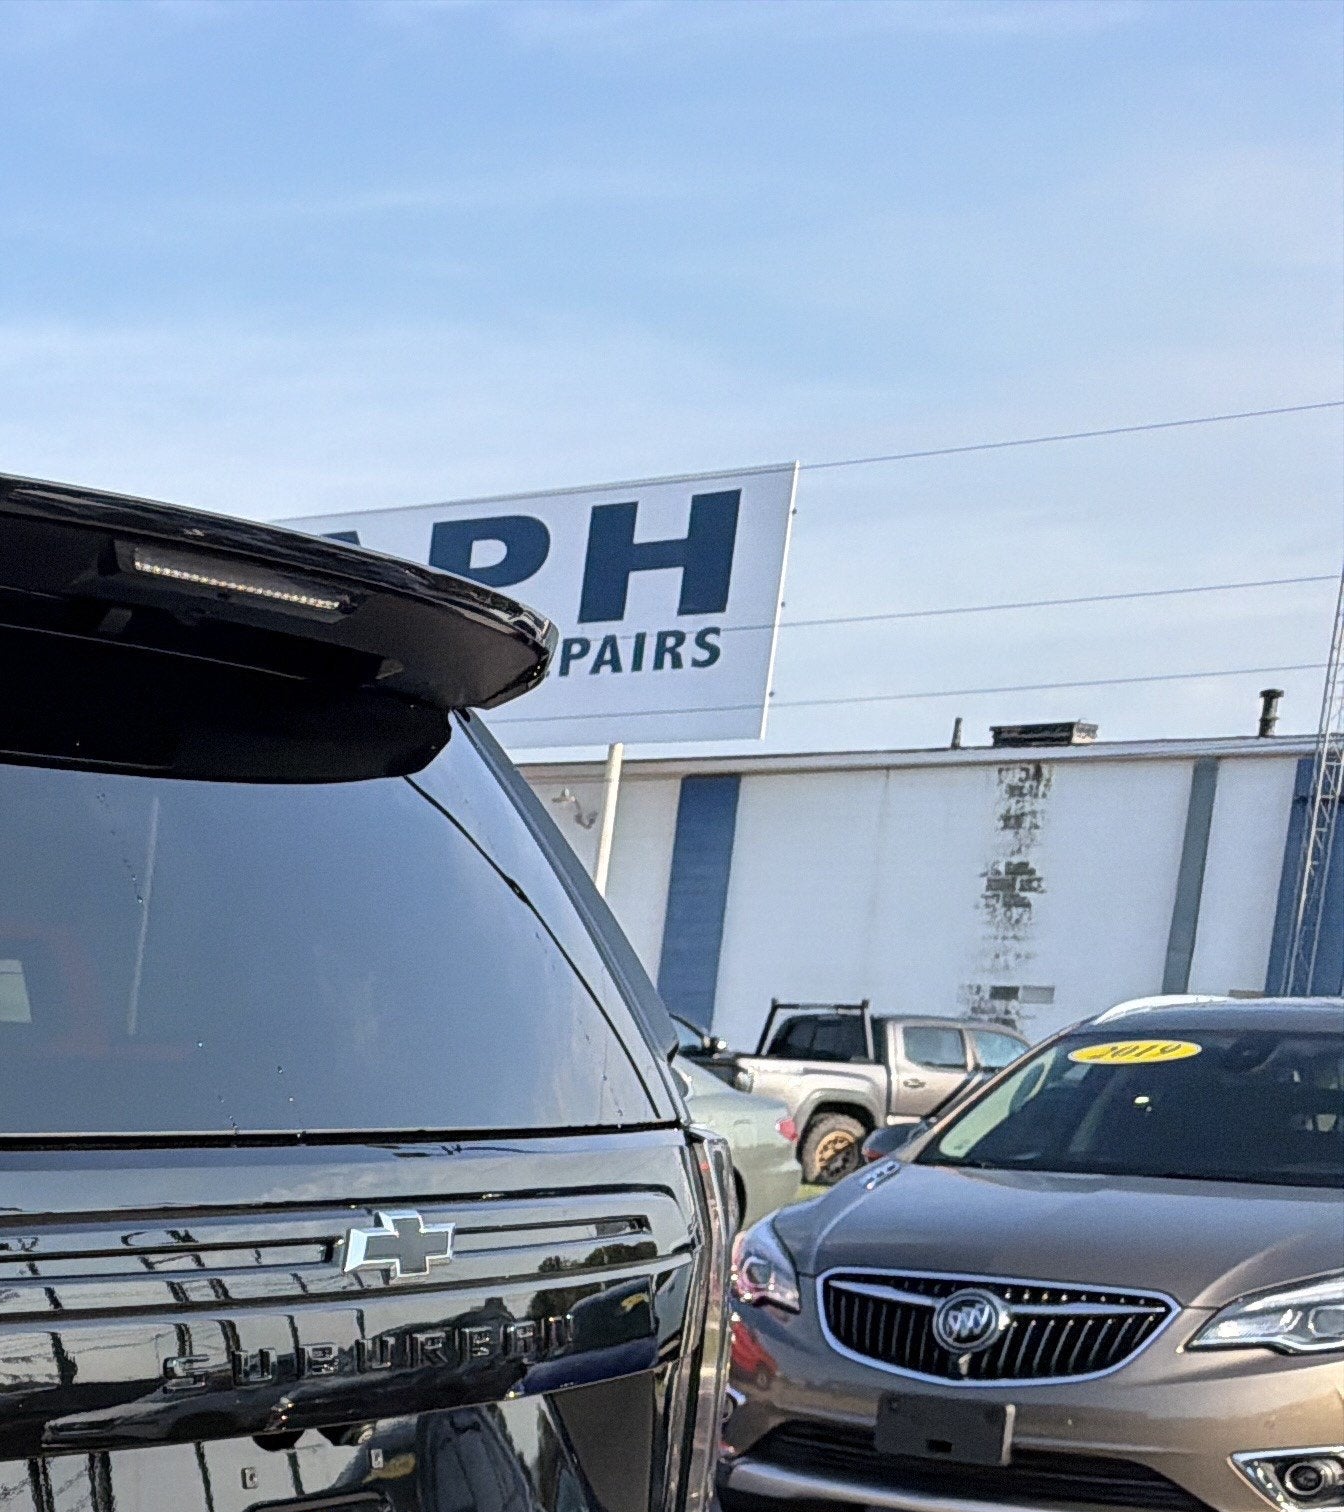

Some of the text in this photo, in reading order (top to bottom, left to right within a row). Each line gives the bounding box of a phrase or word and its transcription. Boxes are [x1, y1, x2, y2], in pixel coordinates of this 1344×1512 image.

[318, 488, 742, 624] PH
[545, 626, 721, 677] PAIRS
[1085, 1043, 1183, 1060] 2019
